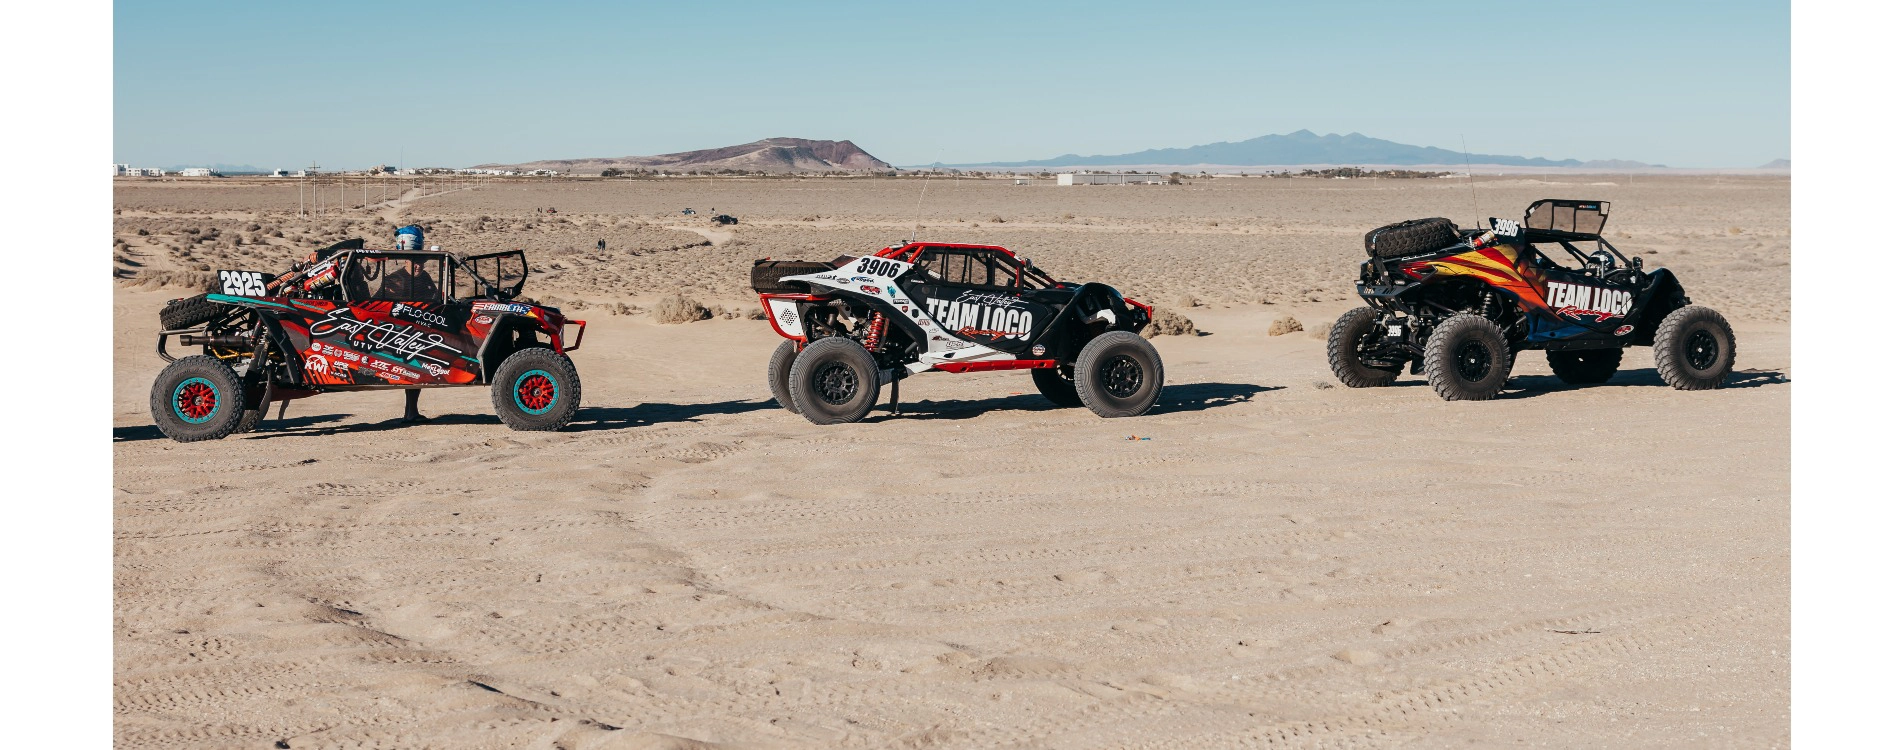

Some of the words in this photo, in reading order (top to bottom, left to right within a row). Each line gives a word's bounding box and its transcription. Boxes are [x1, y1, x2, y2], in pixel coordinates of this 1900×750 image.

[1493, 218, 1520, 237] 3996
[856, 257, 901, 279] 3906
[220, 270, 266, 297] 2925
[955, 289, 984, 304] East
[982, 293, 1030, 309] Valley
[1546, 281, 1592, 310] TEAM
[1592, 286, 1634, 316] LOCO
[926, 297, 980, 332] TEAM
[980, 305, 1033, 342] LOCO
[310, 308, 373, 341] East
[367, 323, 462, 366] Valley
[353, 340, 373, 350] UTV
